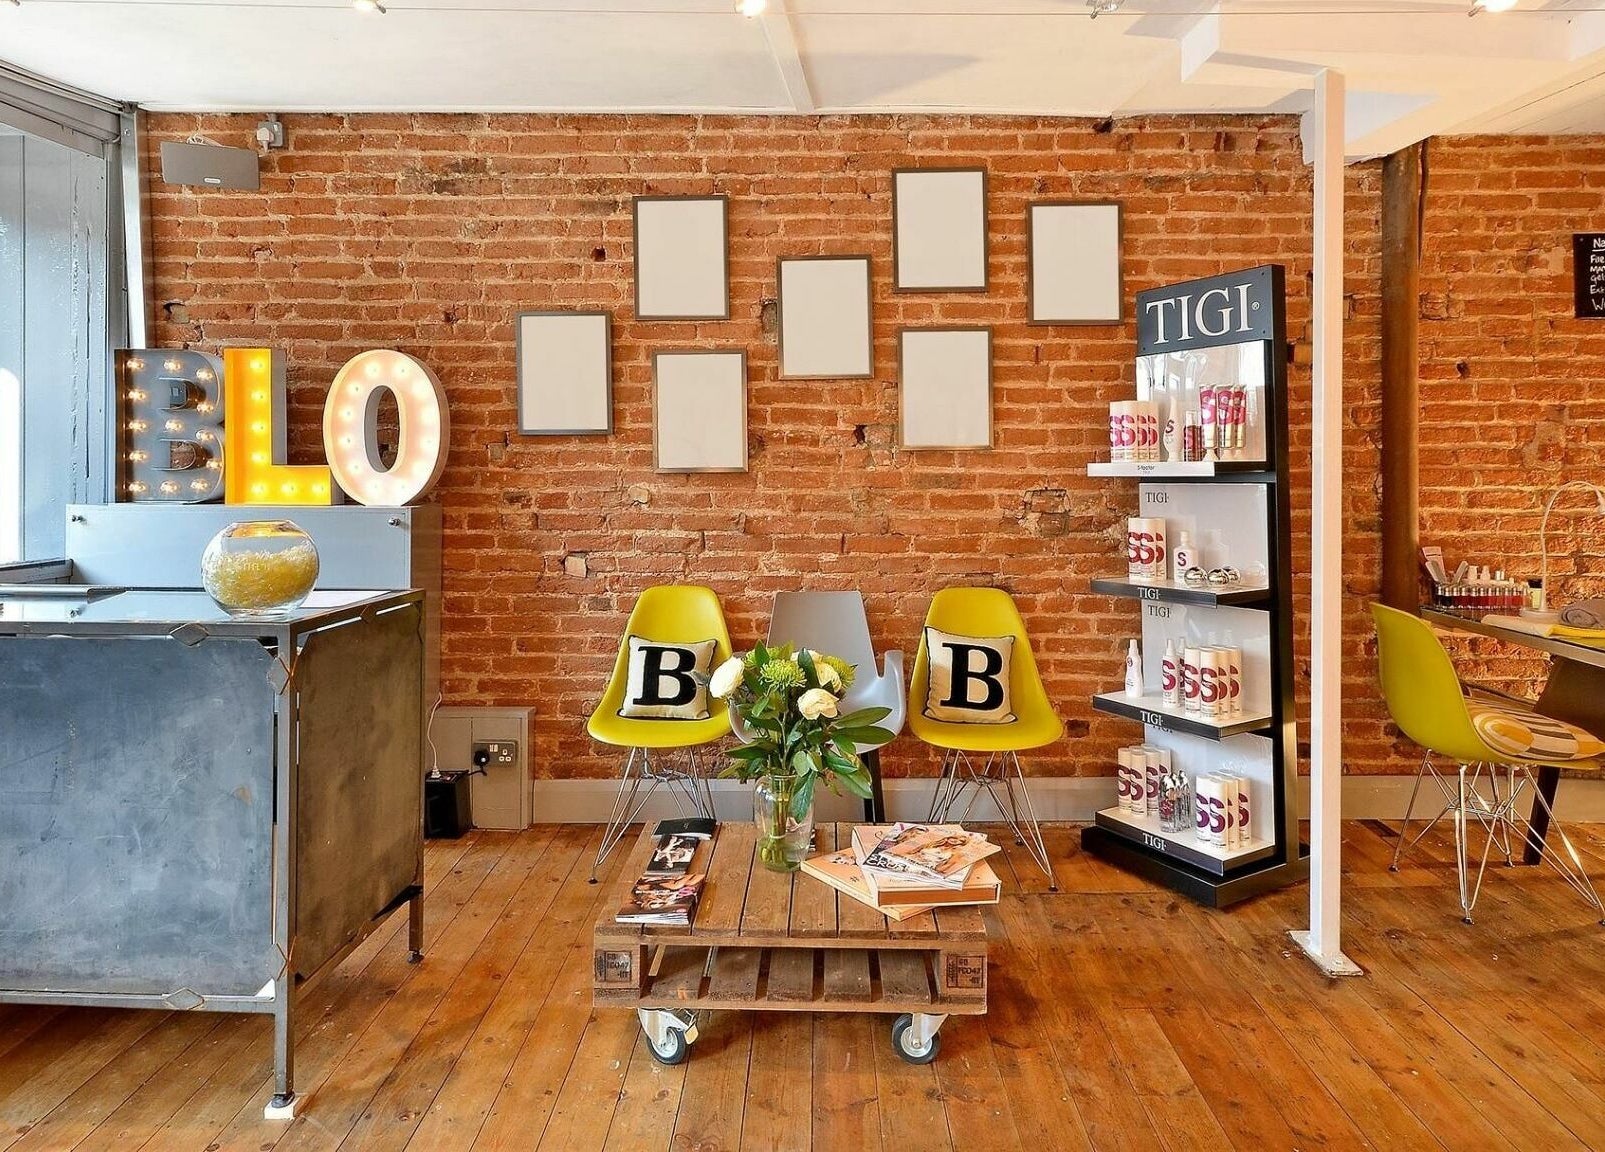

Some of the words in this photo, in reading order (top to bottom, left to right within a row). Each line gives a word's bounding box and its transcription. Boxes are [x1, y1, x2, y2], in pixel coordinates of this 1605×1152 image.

[1146, 283, 1254, 345] TIGI
[115, 348, 450, 506] BLO
[1145, 492, 1169, 503] TIGI
[1178, 552, 1187, 567] S
[1138, 587, 1160, 600] TIGI
[1148, 605, 1171, 618] TIGI
[632, 645, 697, 706] B
[938, 642, 1004, 710] B
[1201, 668, 1218, 702] S
[1140, 711, 1163, 725] TIGI
[1143, 833, 1166, 851] TIGI
